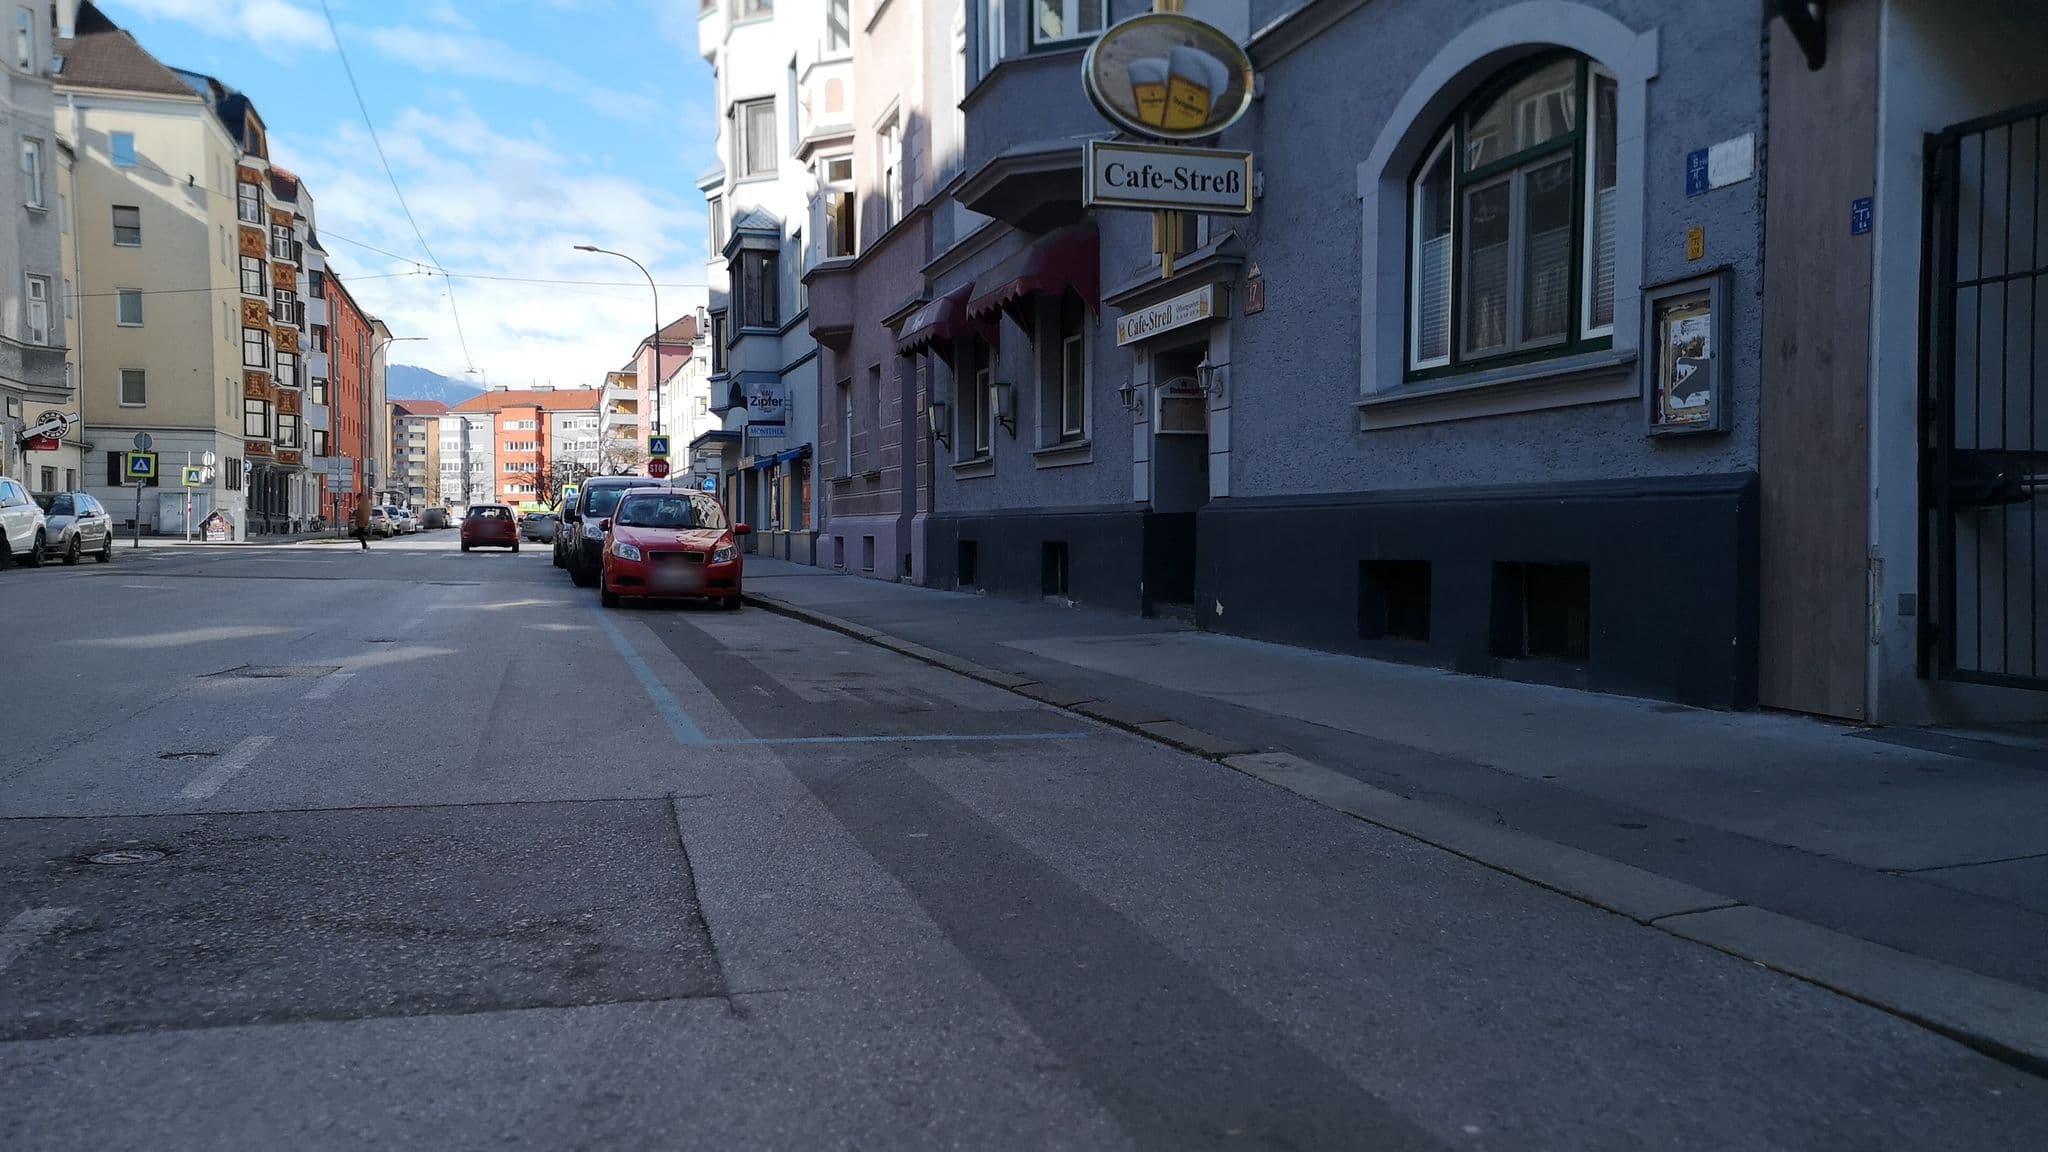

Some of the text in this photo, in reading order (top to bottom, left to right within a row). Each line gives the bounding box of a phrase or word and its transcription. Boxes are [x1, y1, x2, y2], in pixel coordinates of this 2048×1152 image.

[1104, 162, 1240, 194] Cafe-Streß
[1249, 283, 1258, 302] 17
[1127, 304, 1173, 338] Cafe-Streß
[750, 395, 783, 409] Zipfer
[648, 464, 668, 474] STOP
